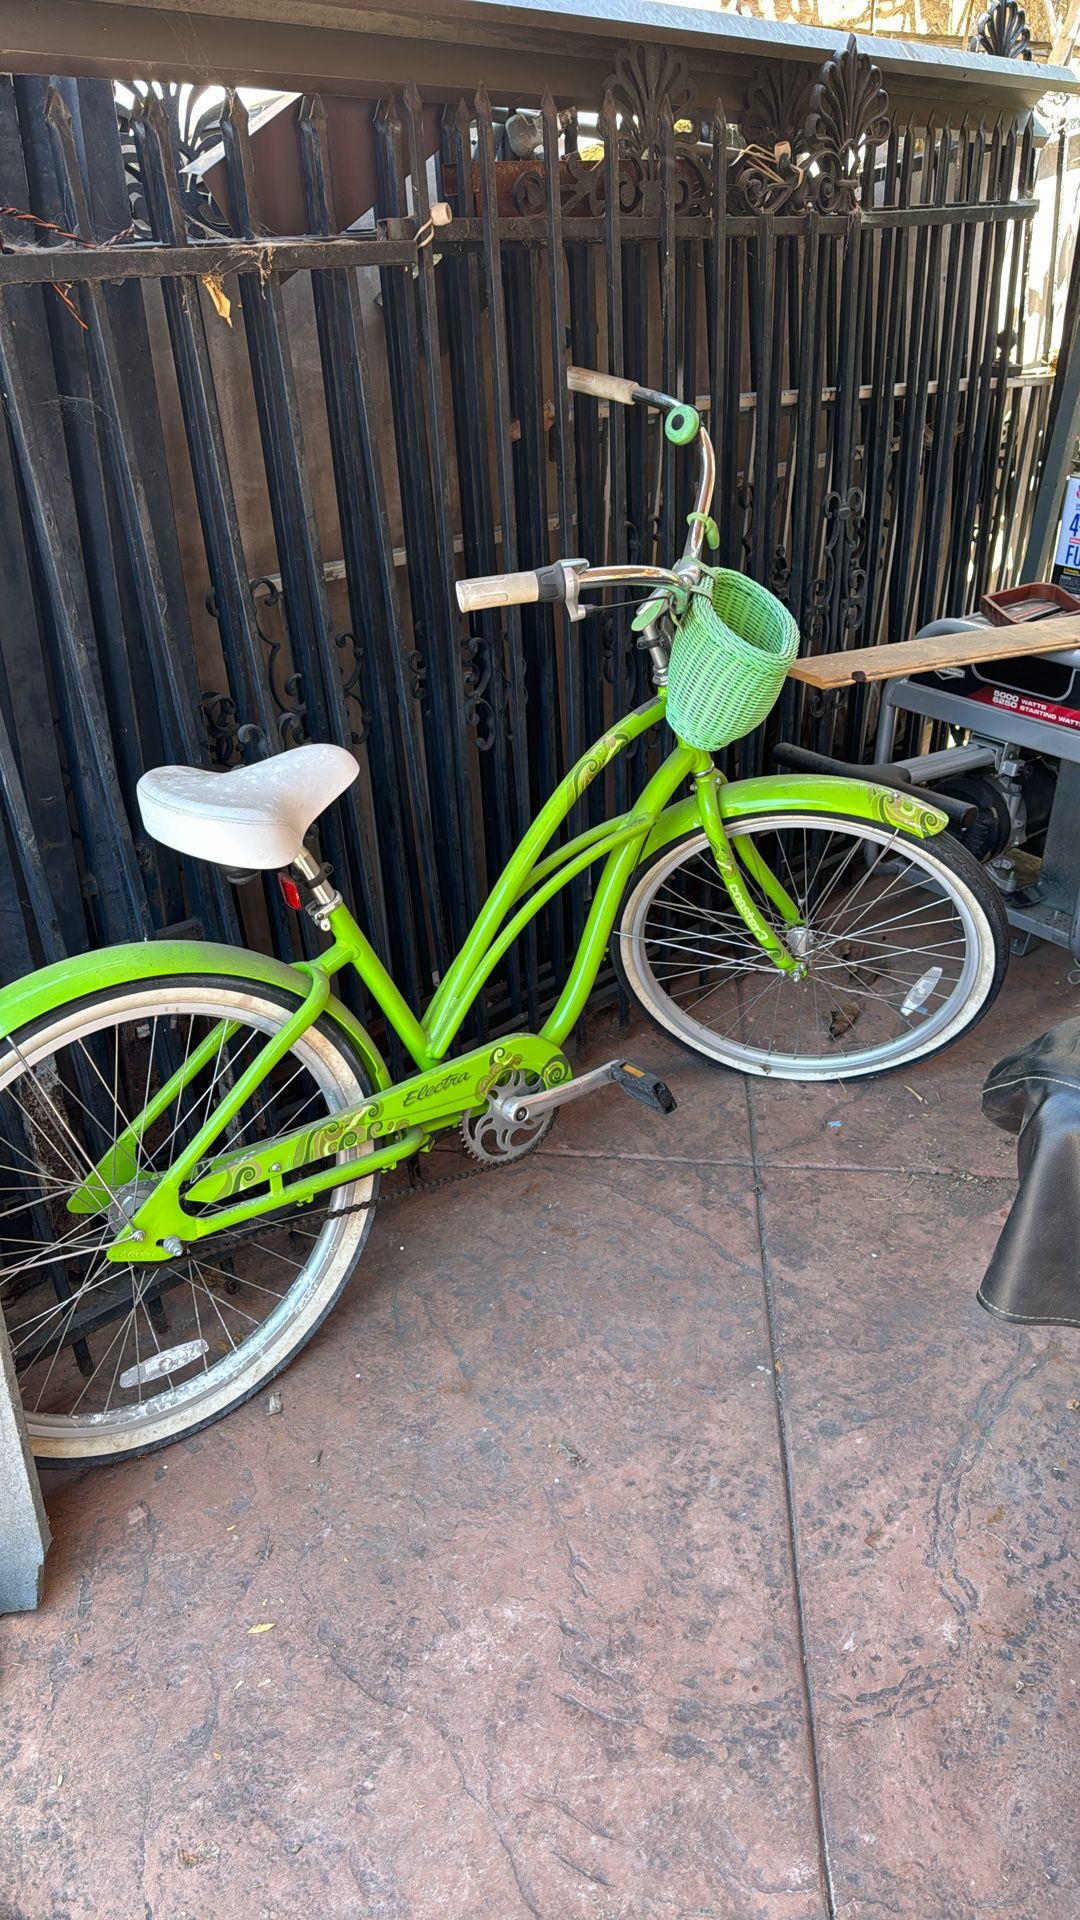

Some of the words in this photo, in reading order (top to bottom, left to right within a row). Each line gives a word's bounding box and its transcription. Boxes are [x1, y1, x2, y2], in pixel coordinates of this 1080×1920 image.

[1069, 513, 1080, 537] 4
[992, 696, 1018, 709] 6250
[1019, 705, 1057, 720] STARTING
[1058, 715, 1080, 727] WATT
[993, 689, 1019, 702] 5000
[1021, 699, 1047, 711] WATTS
[403, 1071, 470, 1107] Electra
